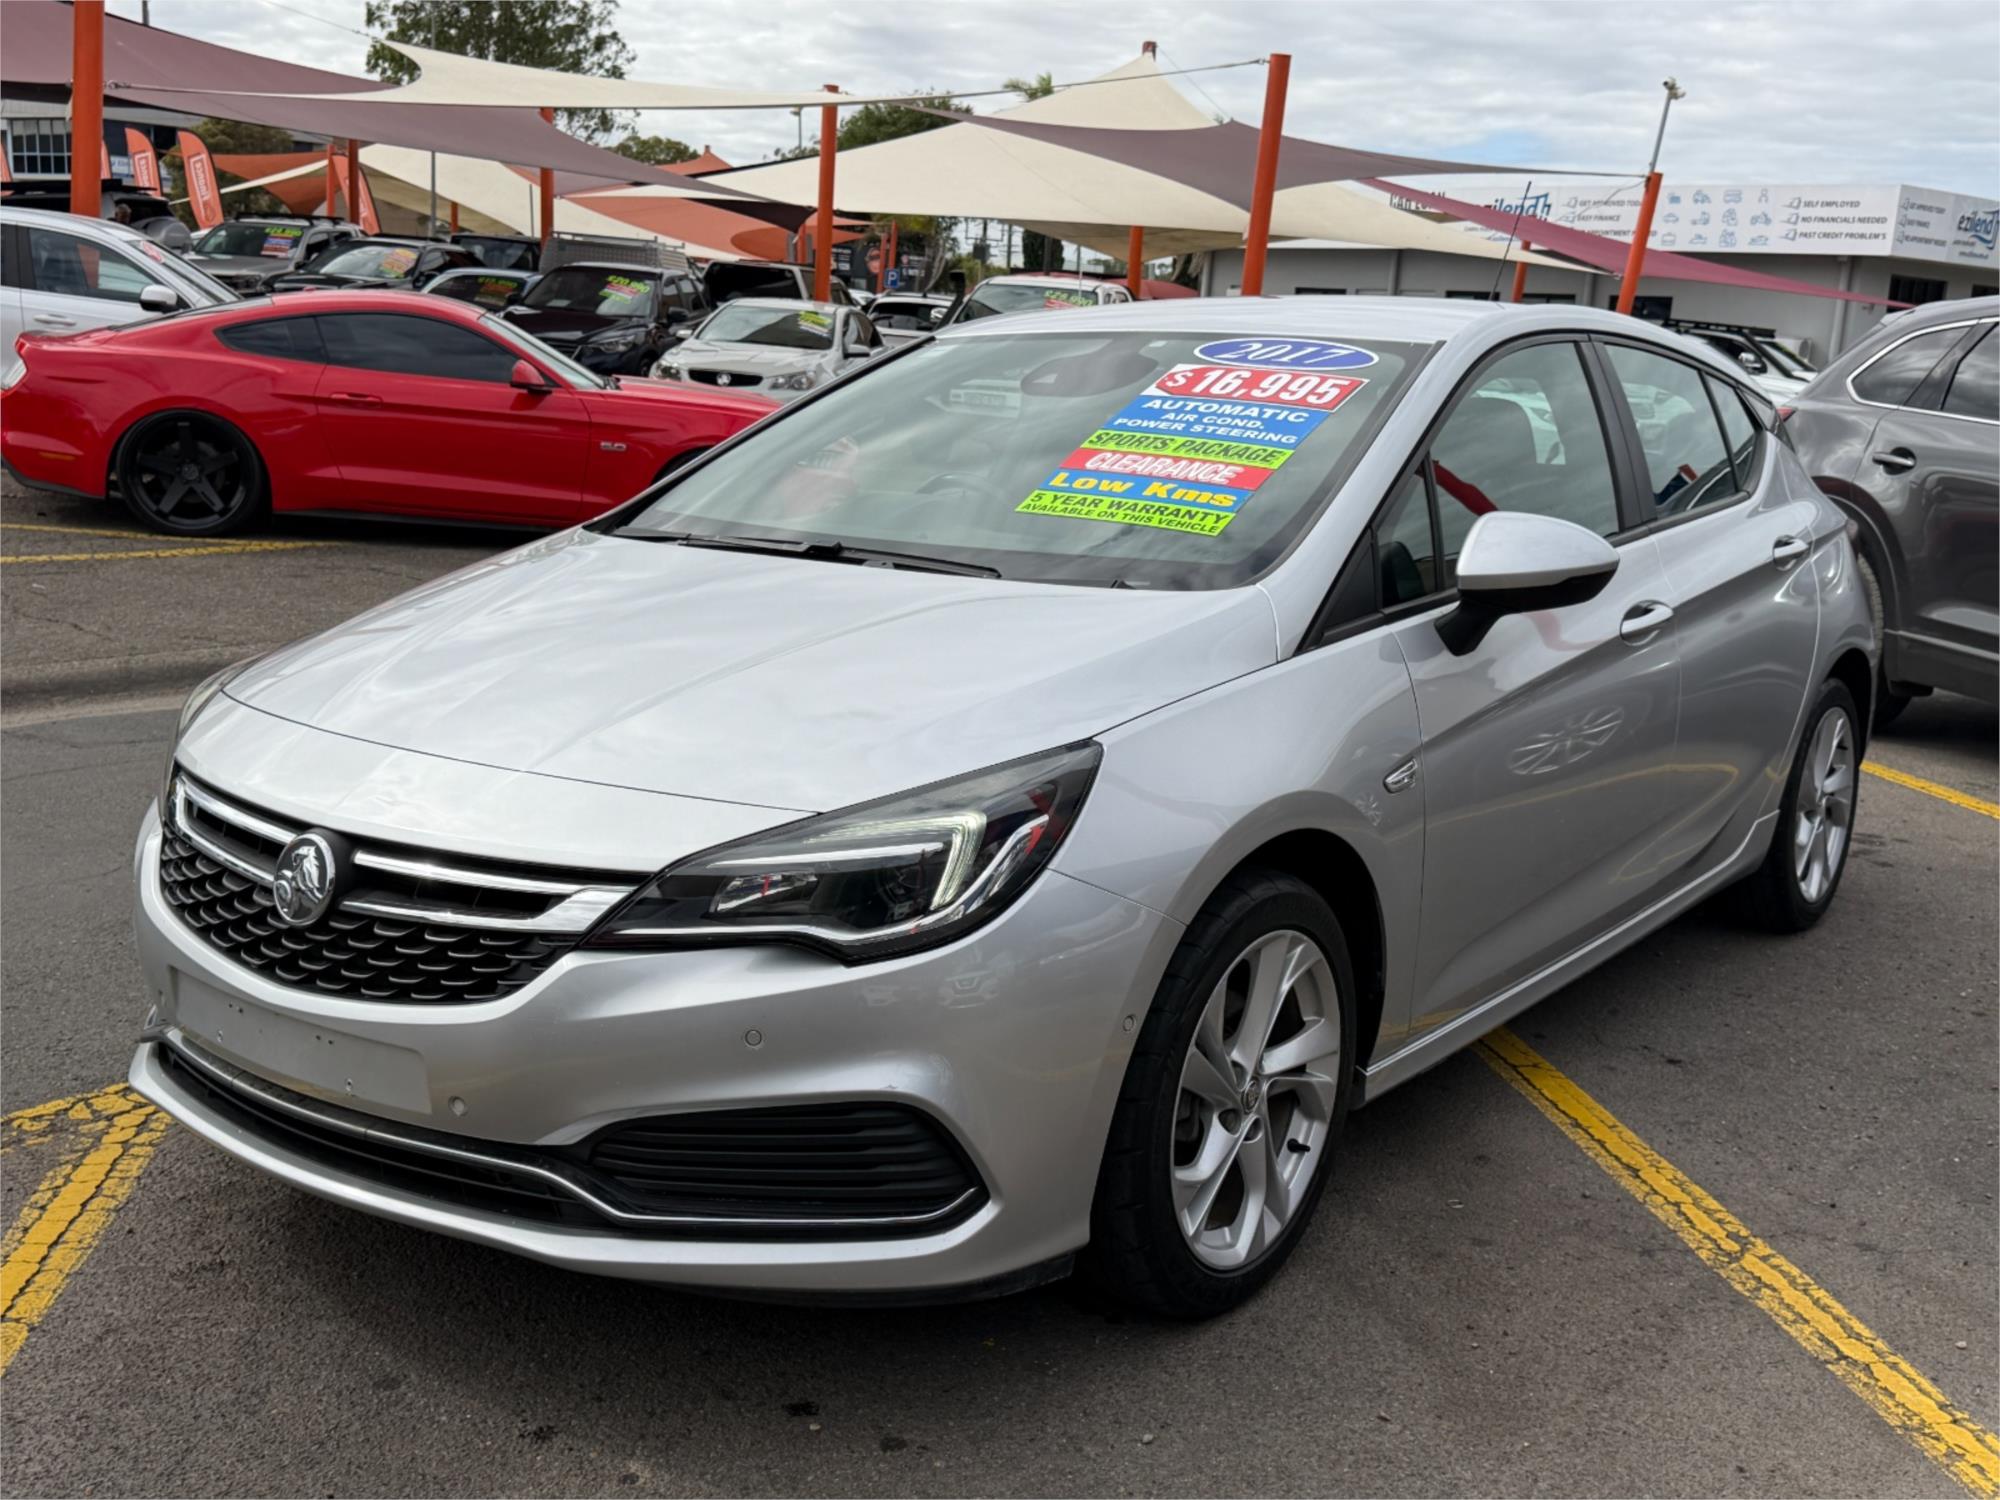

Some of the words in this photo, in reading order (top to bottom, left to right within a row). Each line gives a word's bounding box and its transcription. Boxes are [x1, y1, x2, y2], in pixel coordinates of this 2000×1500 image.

[1803, 200, 1819, 208] SELF
[1820, 200, 1861, 208] EMPLOYED
[1813, 216, 1856, 224] FINANCIALS
[1856, 216, 1888, 224] NEEDED
[1799, 231, 1816, 239] PAST
[1844, 232, 1887, 240] PROBLEM'S
[888, 271, 897, 286] P
[1213, 342, 1356, 364] 2017
[1141, 399, 1310, 423] AUTOMATIC
[1161, 412, 1195, 422] AIR
[1201, 414, 1266, 429] COND.
[1113, 418, 1187, 431] POWER
[1189, 424, 1298, 444] STEERING
[1088, 431, 1174, 450] SPORTS
[1175, 438, 1285, 464] PACKAGE
[1084, 451, 1245, 485] CLEARANCE
[1142, 482, 1238, 507] Kms
[1022, 502, 1094, 517] AVAILABLE
[1096, 510, 1118, 520] ON
[1121, 512, 1154, 523] THIS
[1156, 517, 1220, 534] VEHICLE
[1030, 492, 1043, 502] 5
[1046, 494, 1100, 508] YEAR
[1107, 500, 1230, 525] WARRANTY
